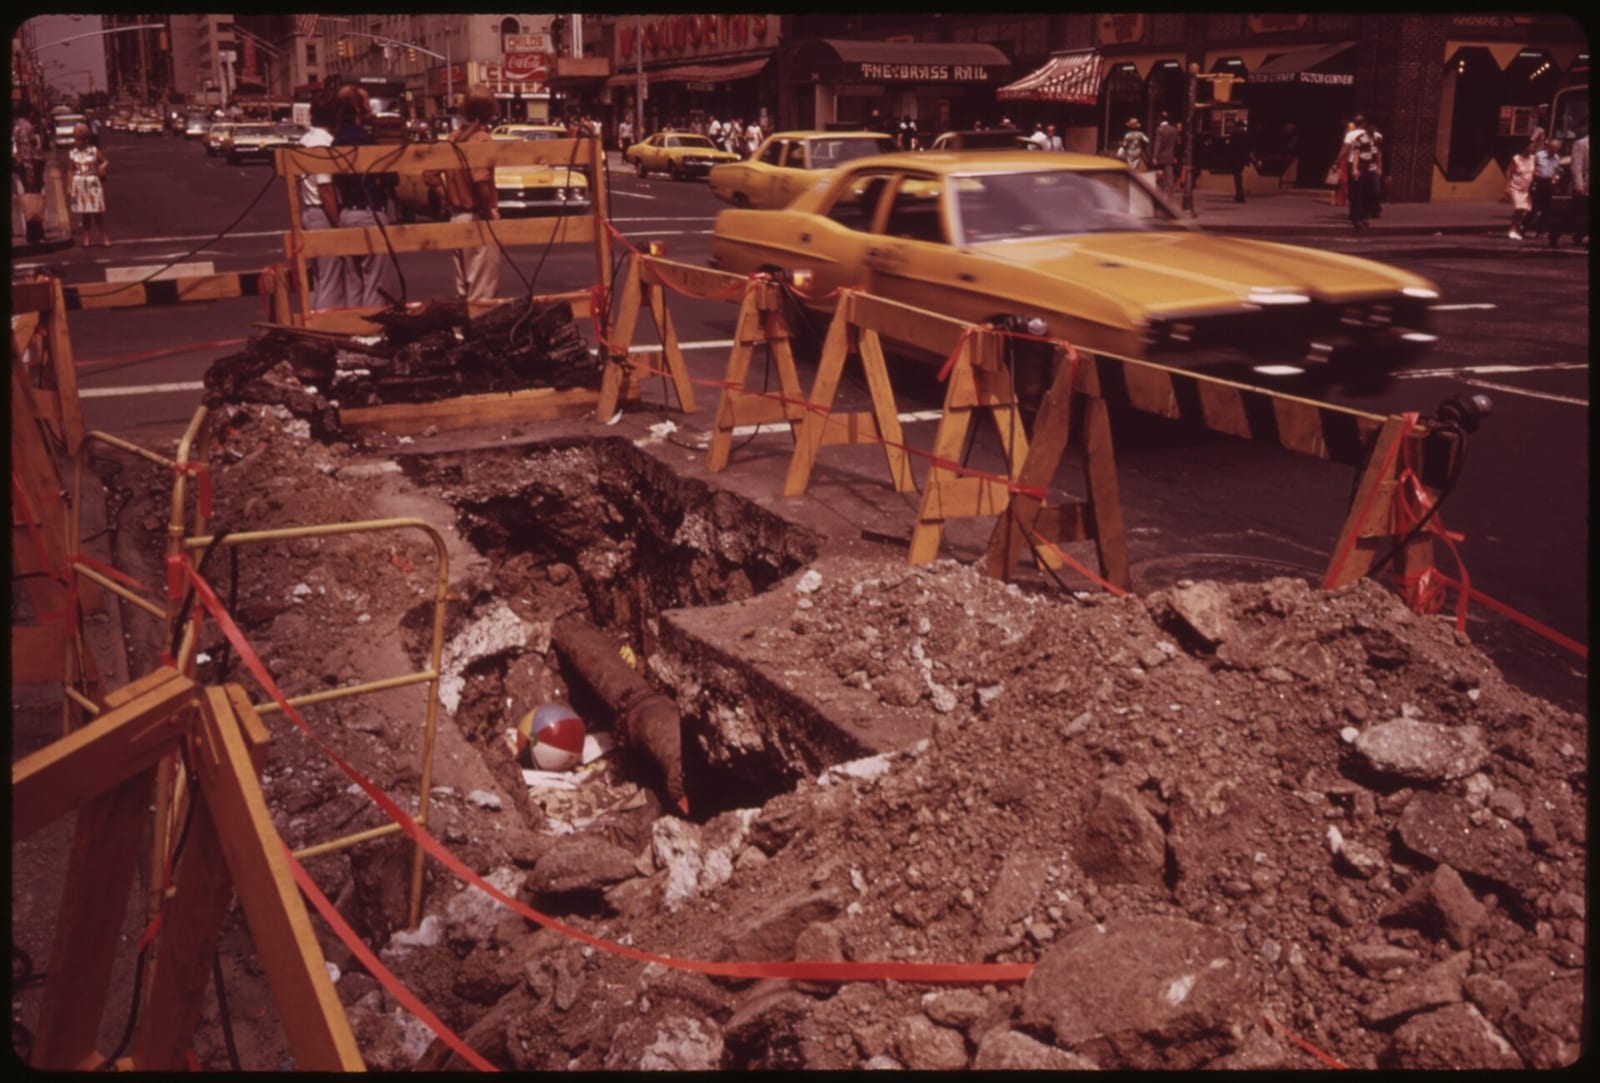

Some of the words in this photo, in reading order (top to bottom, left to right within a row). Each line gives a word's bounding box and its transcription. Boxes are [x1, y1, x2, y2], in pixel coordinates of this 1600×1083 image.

[508, 36, 543, 47] CHILDS
[900, 64, 948, 80] BRASS
[954, 64, 988, 80] RAIL
